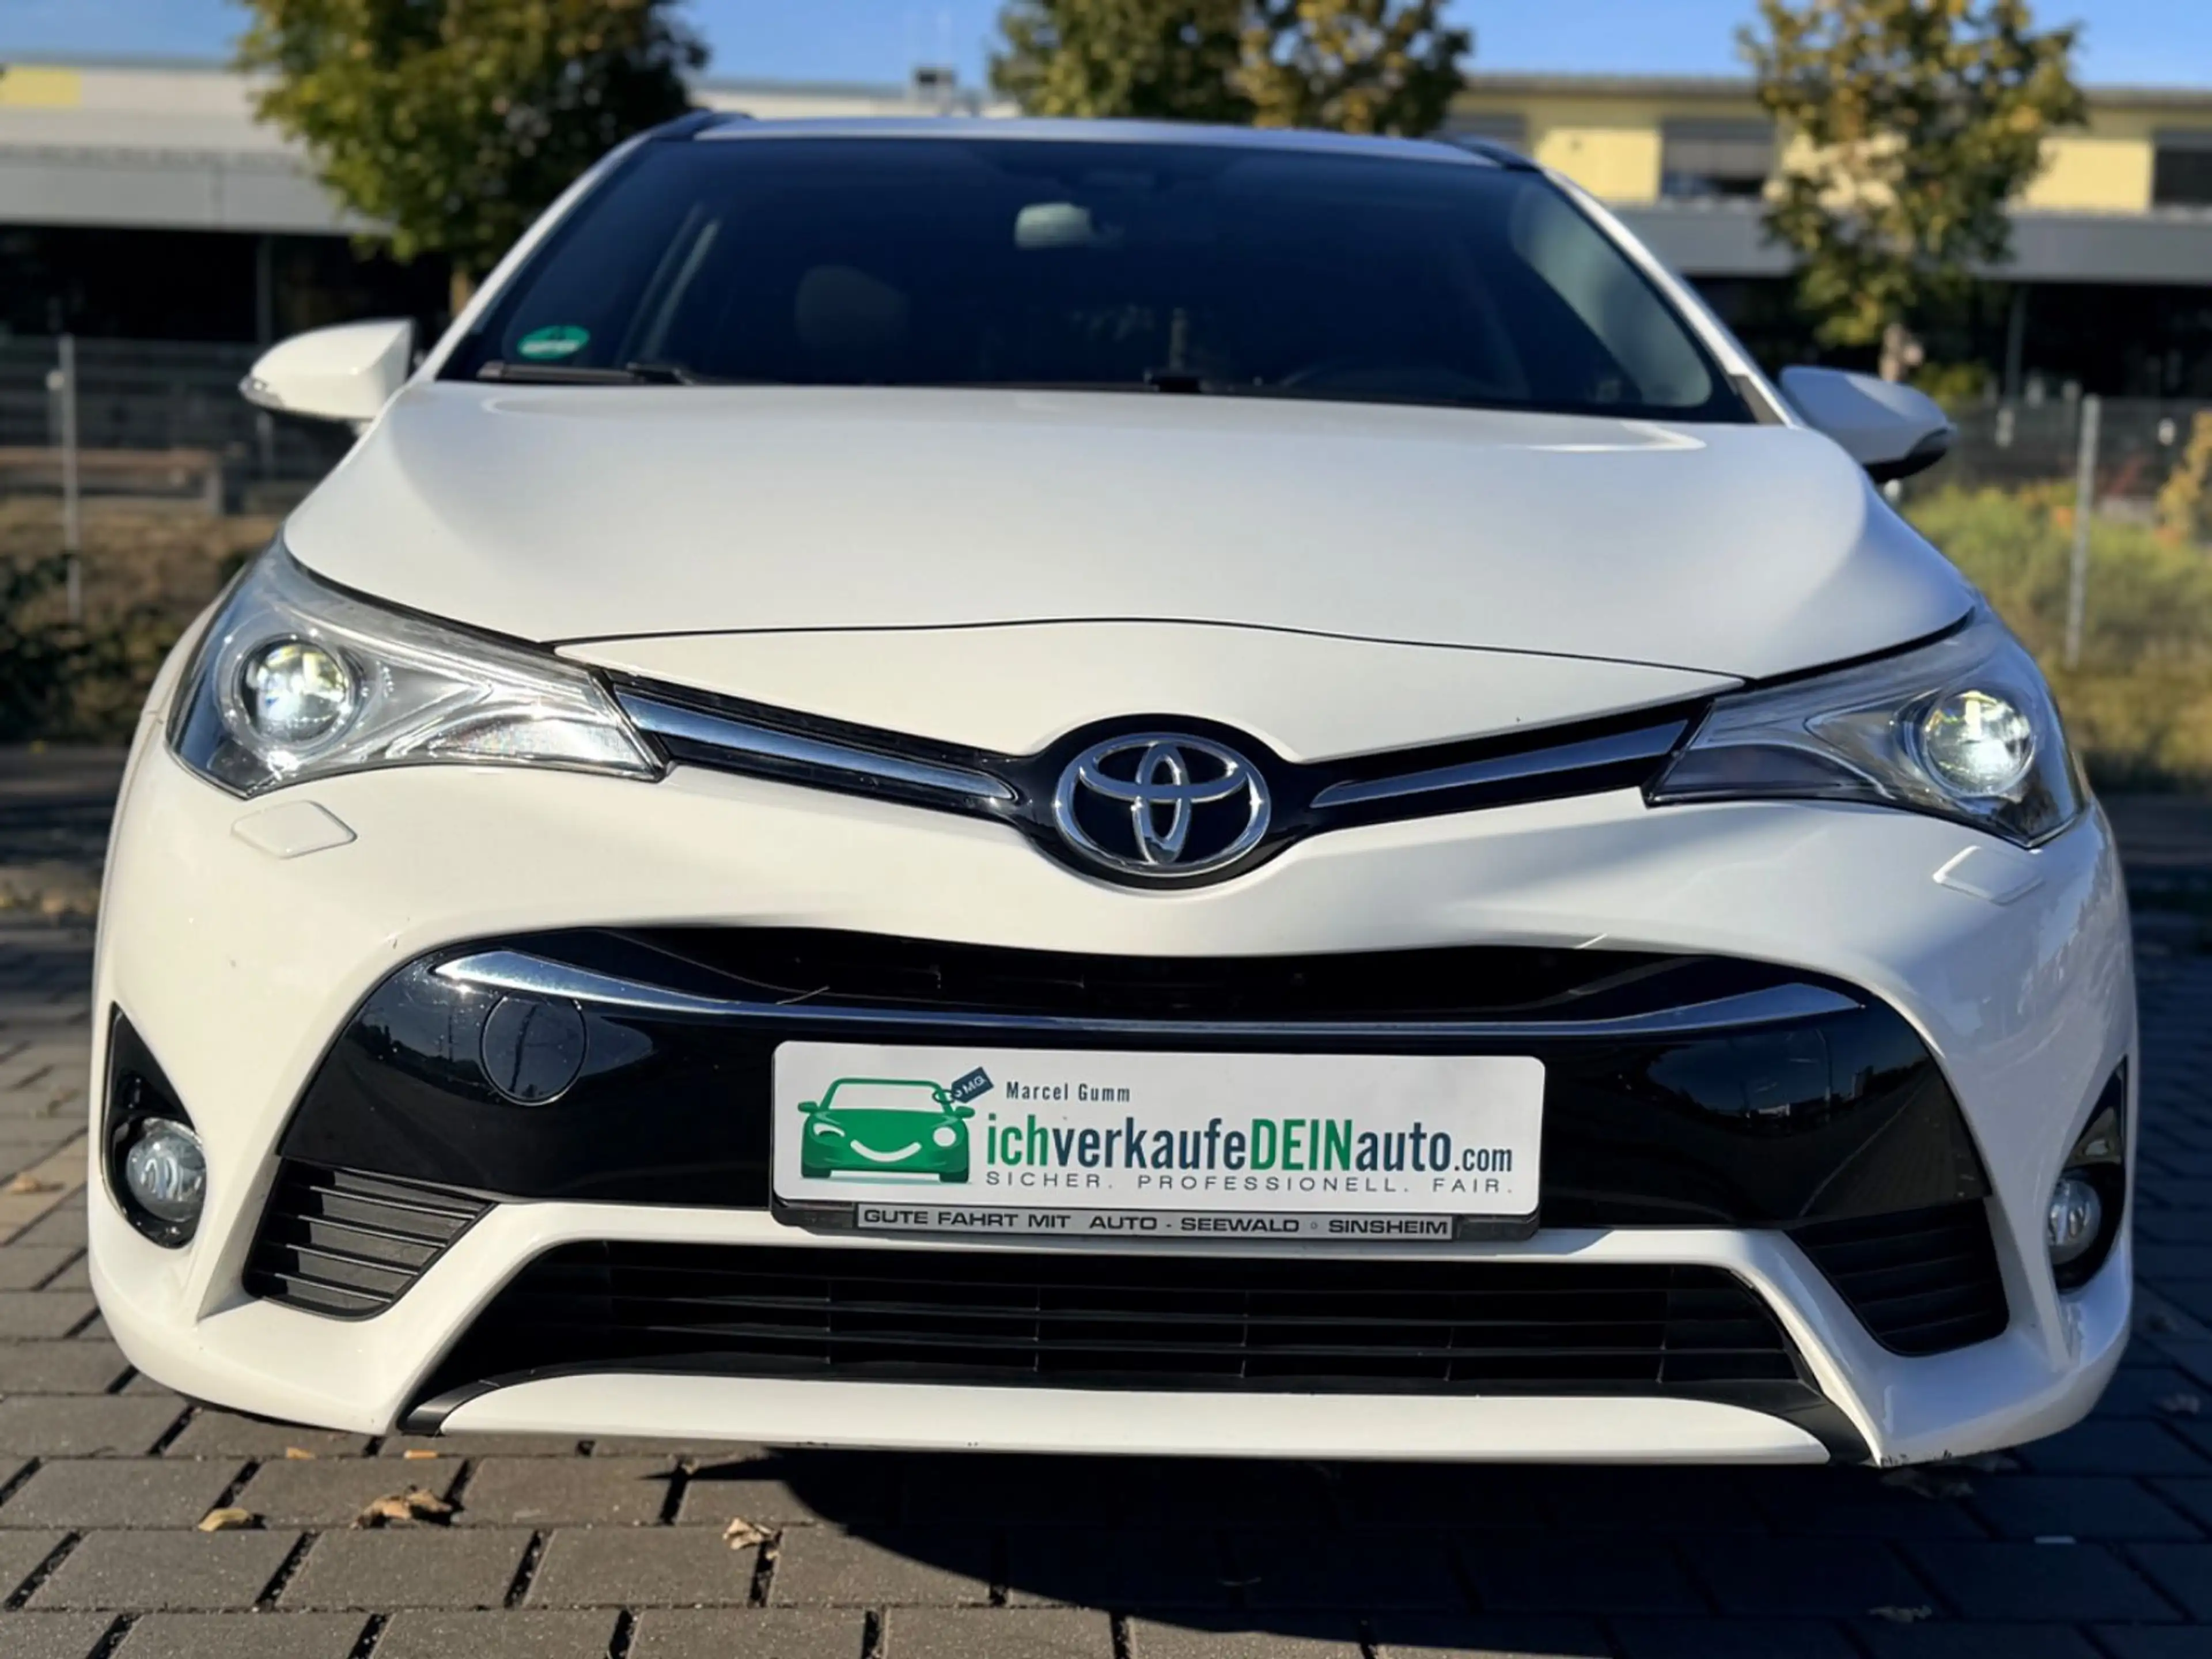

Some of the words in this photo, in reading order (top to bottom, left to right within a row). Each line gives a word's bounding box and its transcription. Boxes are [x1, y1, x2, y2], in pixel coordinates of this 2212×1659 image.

[1006, 1081, 1069, 1101] Marcel
[1078, 1083, 1130, 1102] Gumm
[987, 1113, 1512, 1172] ichverkaufeDEINauto.com
[986, 1171, 1112, 1188] SICHER.
[1138, 1175, 1410, 1193] PROFESSIONELL.
[1433, 1177, 1513, 1193] FAIR.
[864, 1210, 929, 1225] GUTE
[938, 1212, 1018, 1228] FAHRT
[1028, 1213, 1071, 1229] MIT
[1089, 1215, 1157, 1230] AUTO
[1180, 1217, 1300, 1233] SEEWALD
[1328, 1220, 1448, 1234] SINSHEIM
